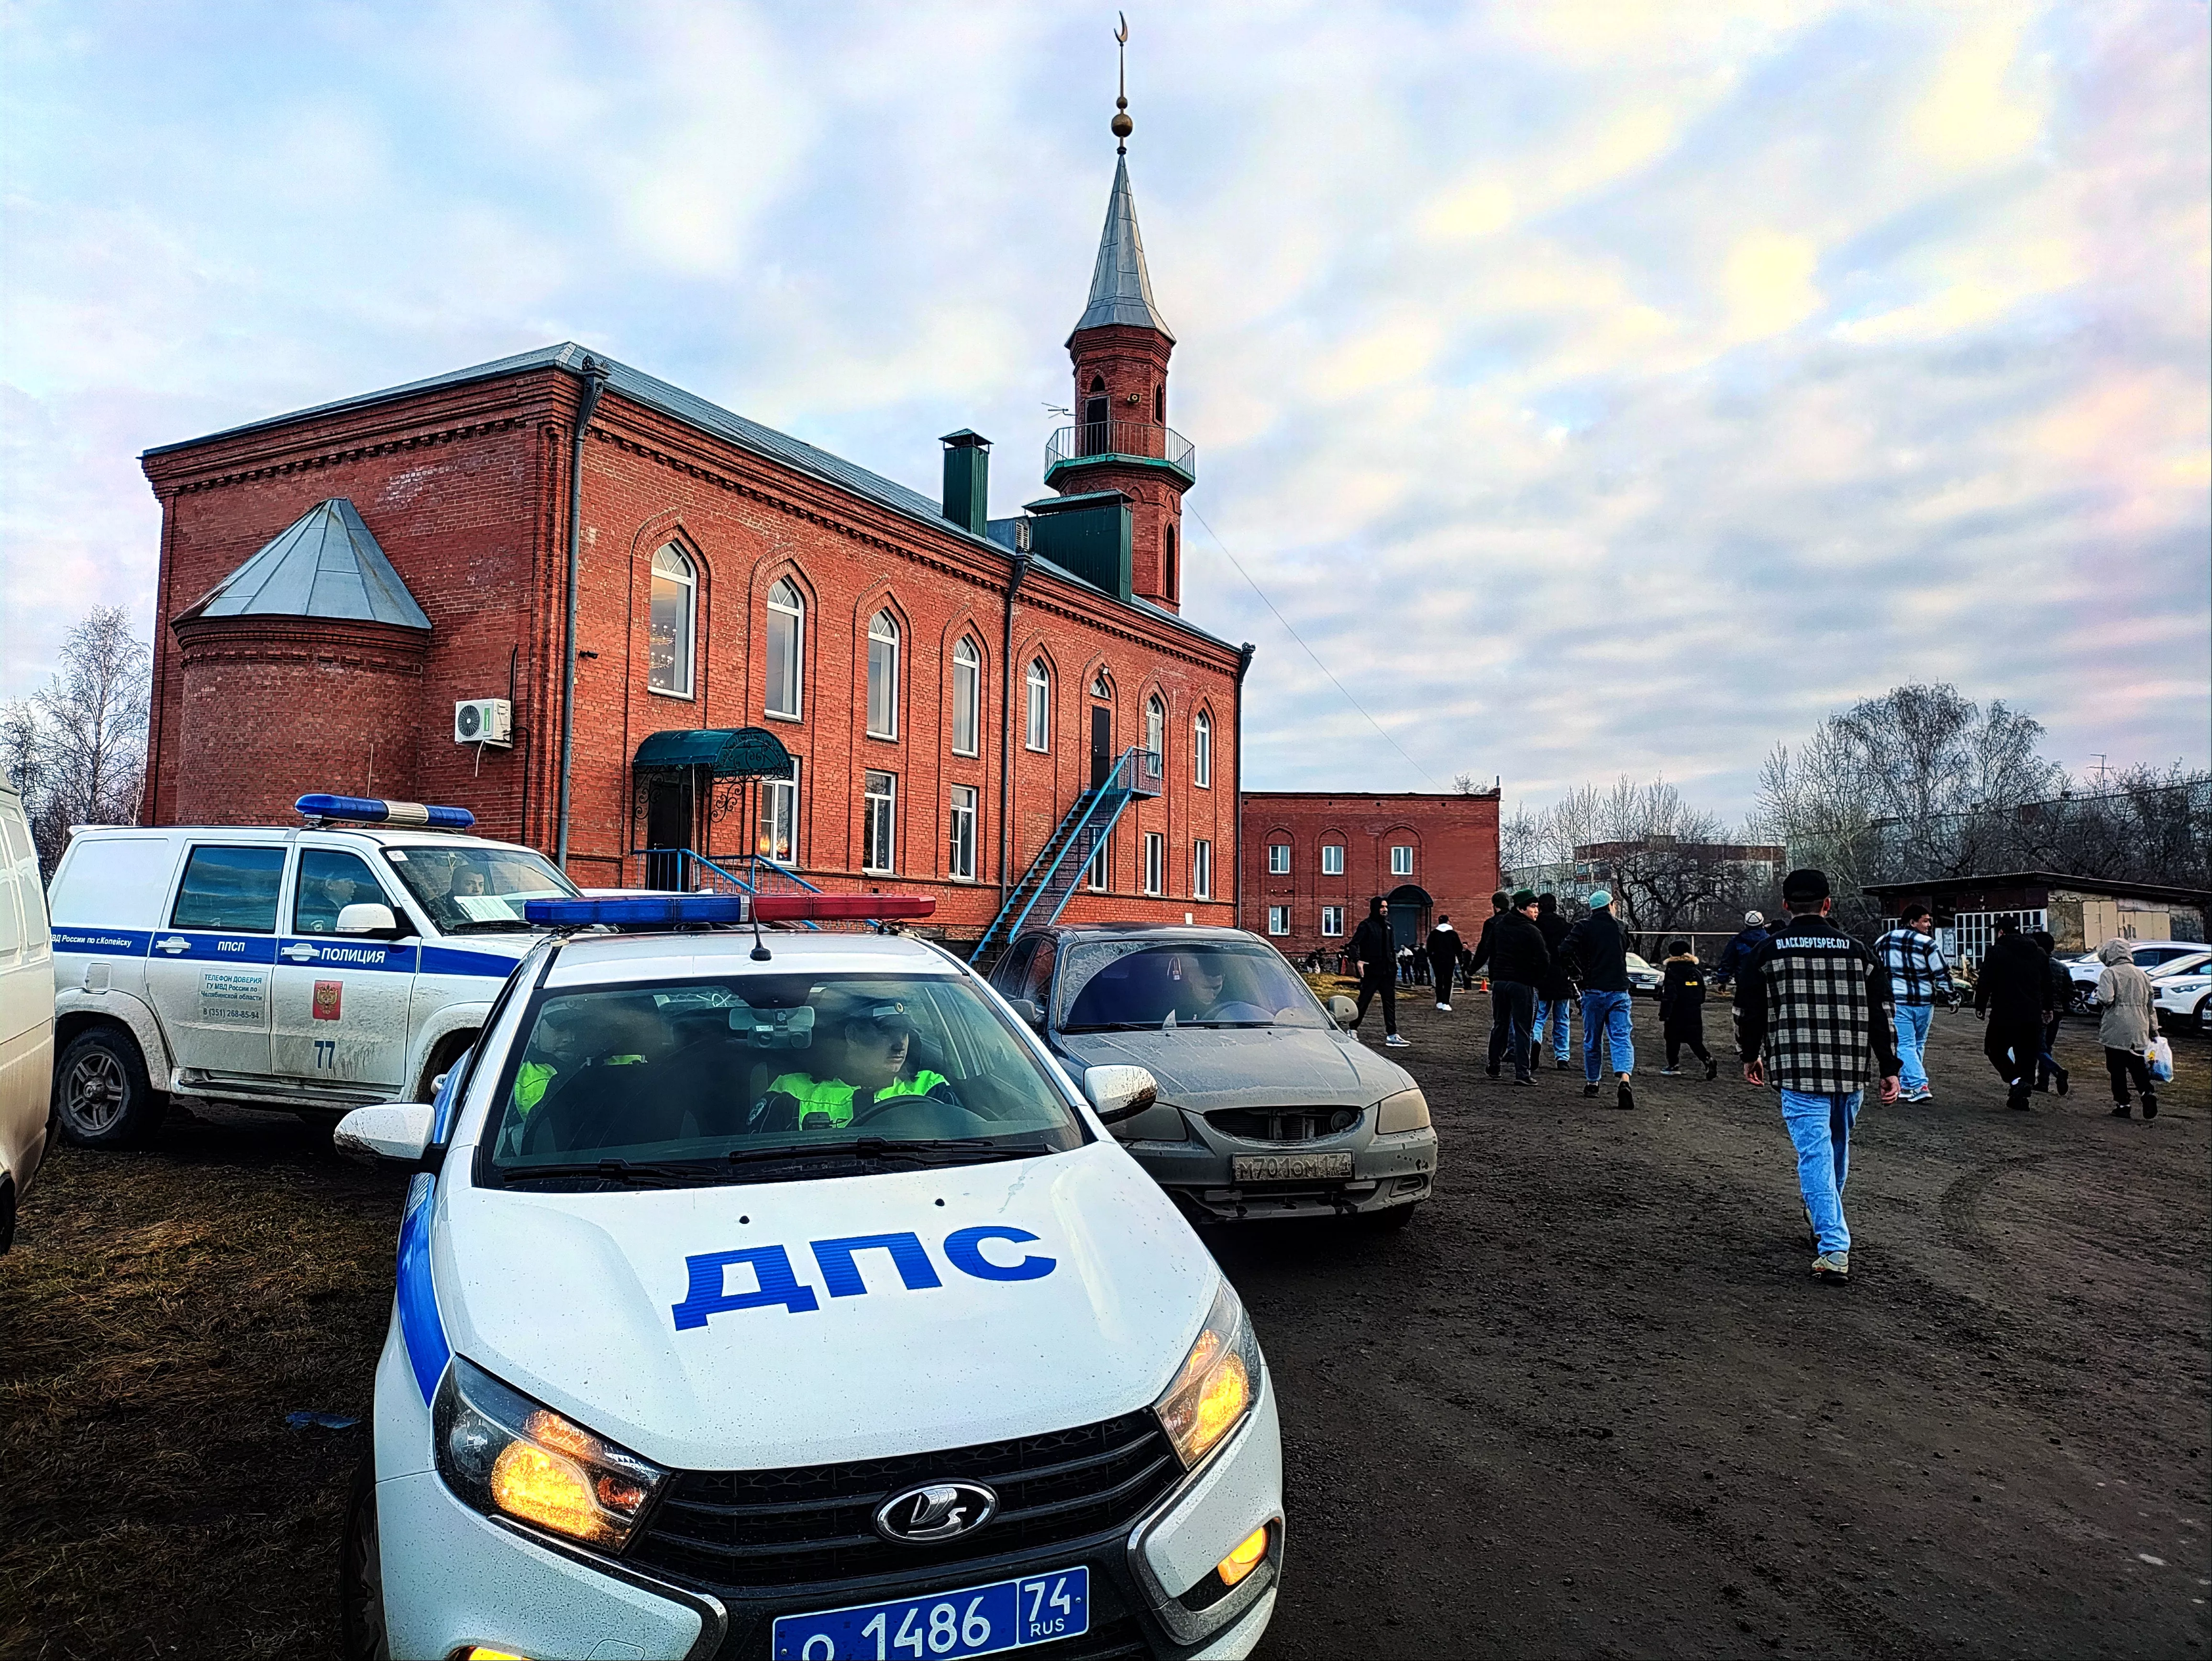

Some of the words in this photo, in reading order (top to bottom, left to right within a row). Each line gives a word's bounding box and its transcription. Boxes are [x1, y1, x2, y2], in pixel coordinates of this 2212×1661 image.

[51, 934, 61, 943] ВД
[62, 935, 85, 943] России
[96, 937, 132, 948] г.Копейску
[217, 941, 245, 952] ППСП
[321, 948, 386, 964] ПОЛИЦИЯ
[205, 974, 232, 982] ТЕЛЕФОН
[233, 976, 262, 984] ДОВЕРИЯ
[201, 990, 238, 999] Челябинской
[209, 1008, 225, 1018] (351)
[227, 1009, 259, 1019] 268-85-94
[314, 1040, 335, 1069] 77
[671, 1226, 1057, 1331] ДПС
[861, 1595, 991, 1661] 1486
[1024, 1577, 1071, 1622] 74
[1030, 1620, 1065, 1637] RUS
